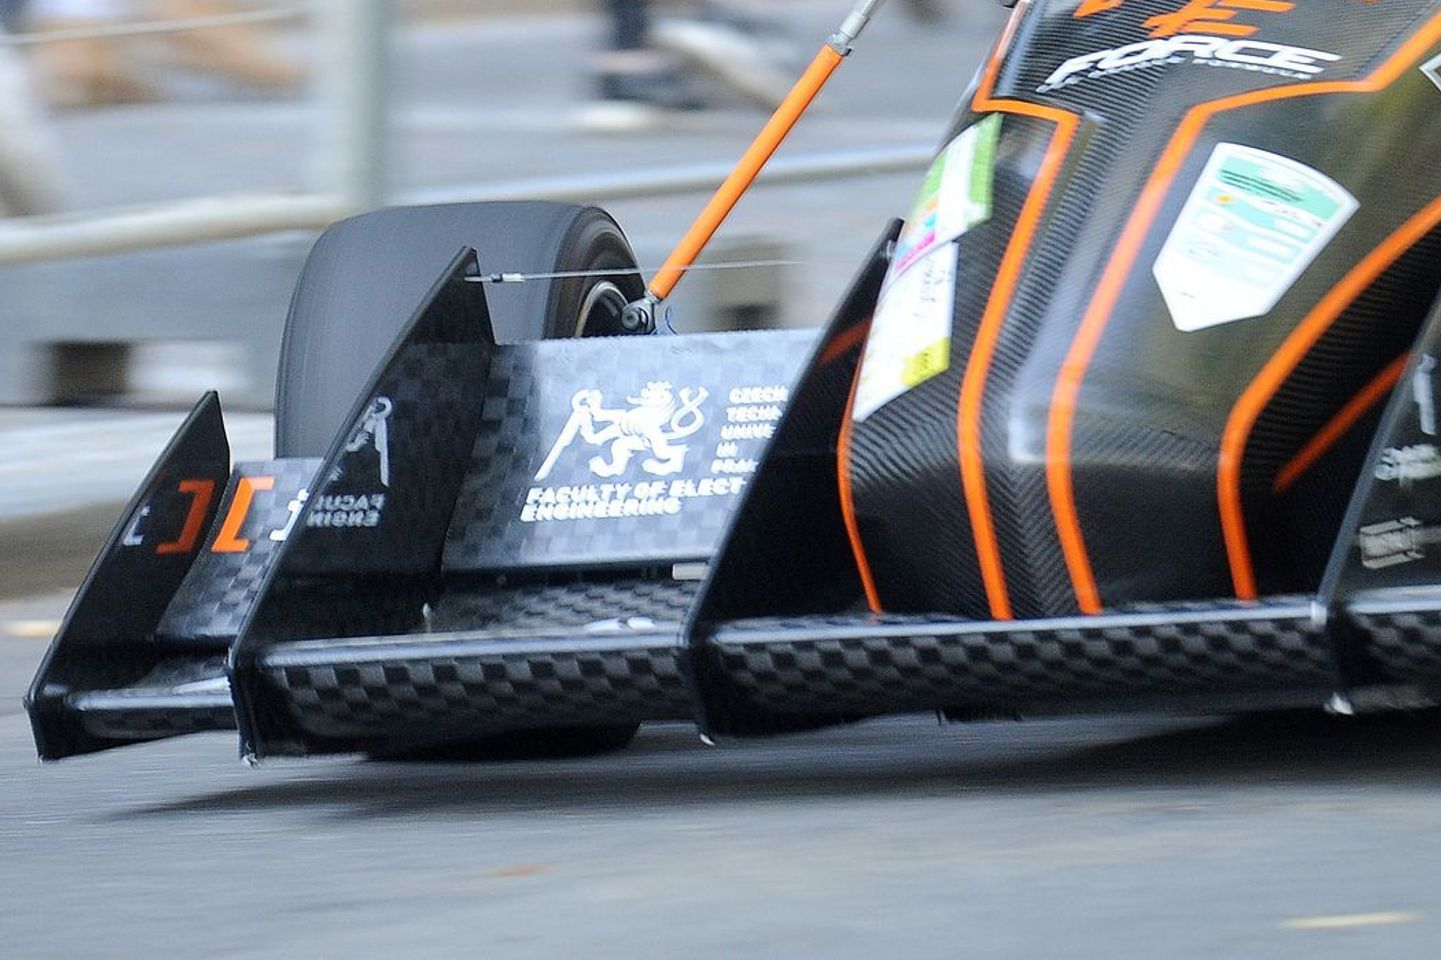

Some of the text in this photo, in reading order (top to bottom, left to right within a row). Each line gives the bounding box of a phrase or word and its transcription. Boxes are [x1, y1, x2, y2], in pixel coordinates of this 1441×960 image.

[1044, 33, 1342, 84] FORCE
[526, 482, 632, 505] FACULTY
[633, 480, 667, 501] OF
[520, 497, 682, 522] ENGINEERING
